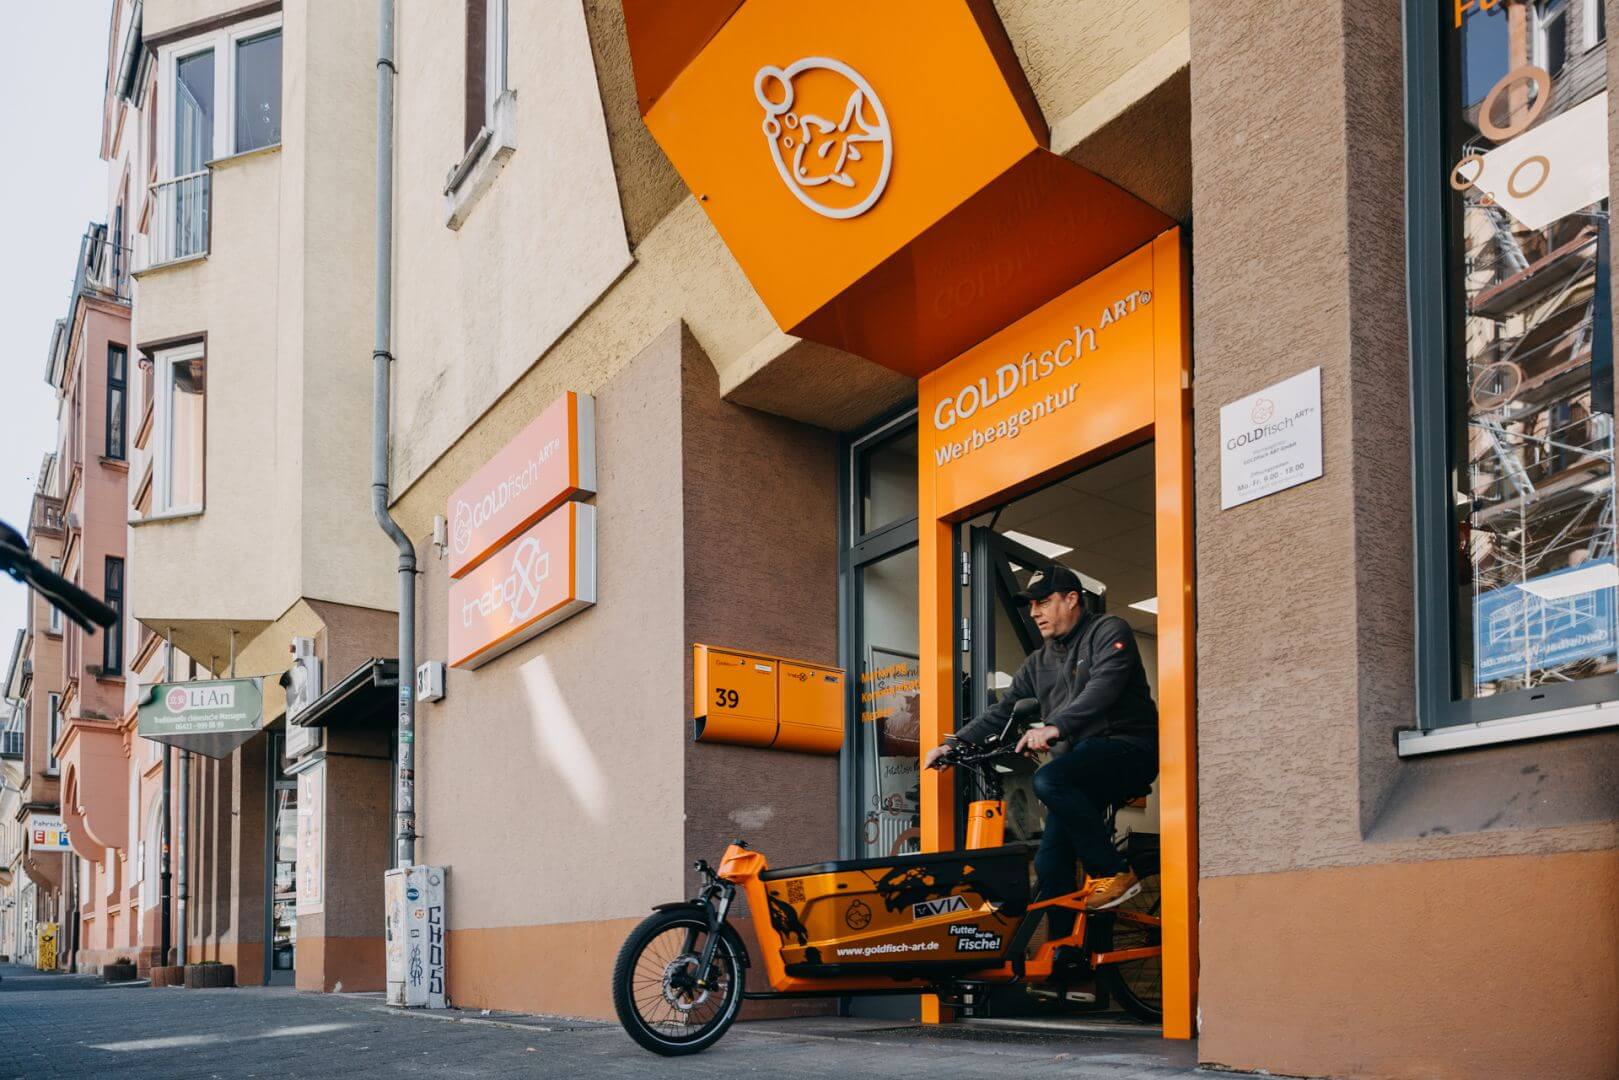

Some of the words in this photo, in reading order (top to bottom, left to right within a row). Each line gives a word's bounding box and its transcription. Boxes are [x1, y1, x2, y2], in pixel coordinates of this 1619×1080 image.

[934, 325, 1098, 430] GOLDfisch
[934, 381, 1081, 467] Werbeagentur
[1226, 417, 1294, 451] GOLDfisch
[473, 460, 538, 528] GOLDfisch
[715, 687, 739, 709] 39
[33, 819, 62, 828] Fahrsch
[929, 896, 970, 917] VIA
[950, 925, 977, 935] Futter
[836, 941, 939, 957] www.goldfisch-art.de
[958, 938, 1001, 951] Fische!
